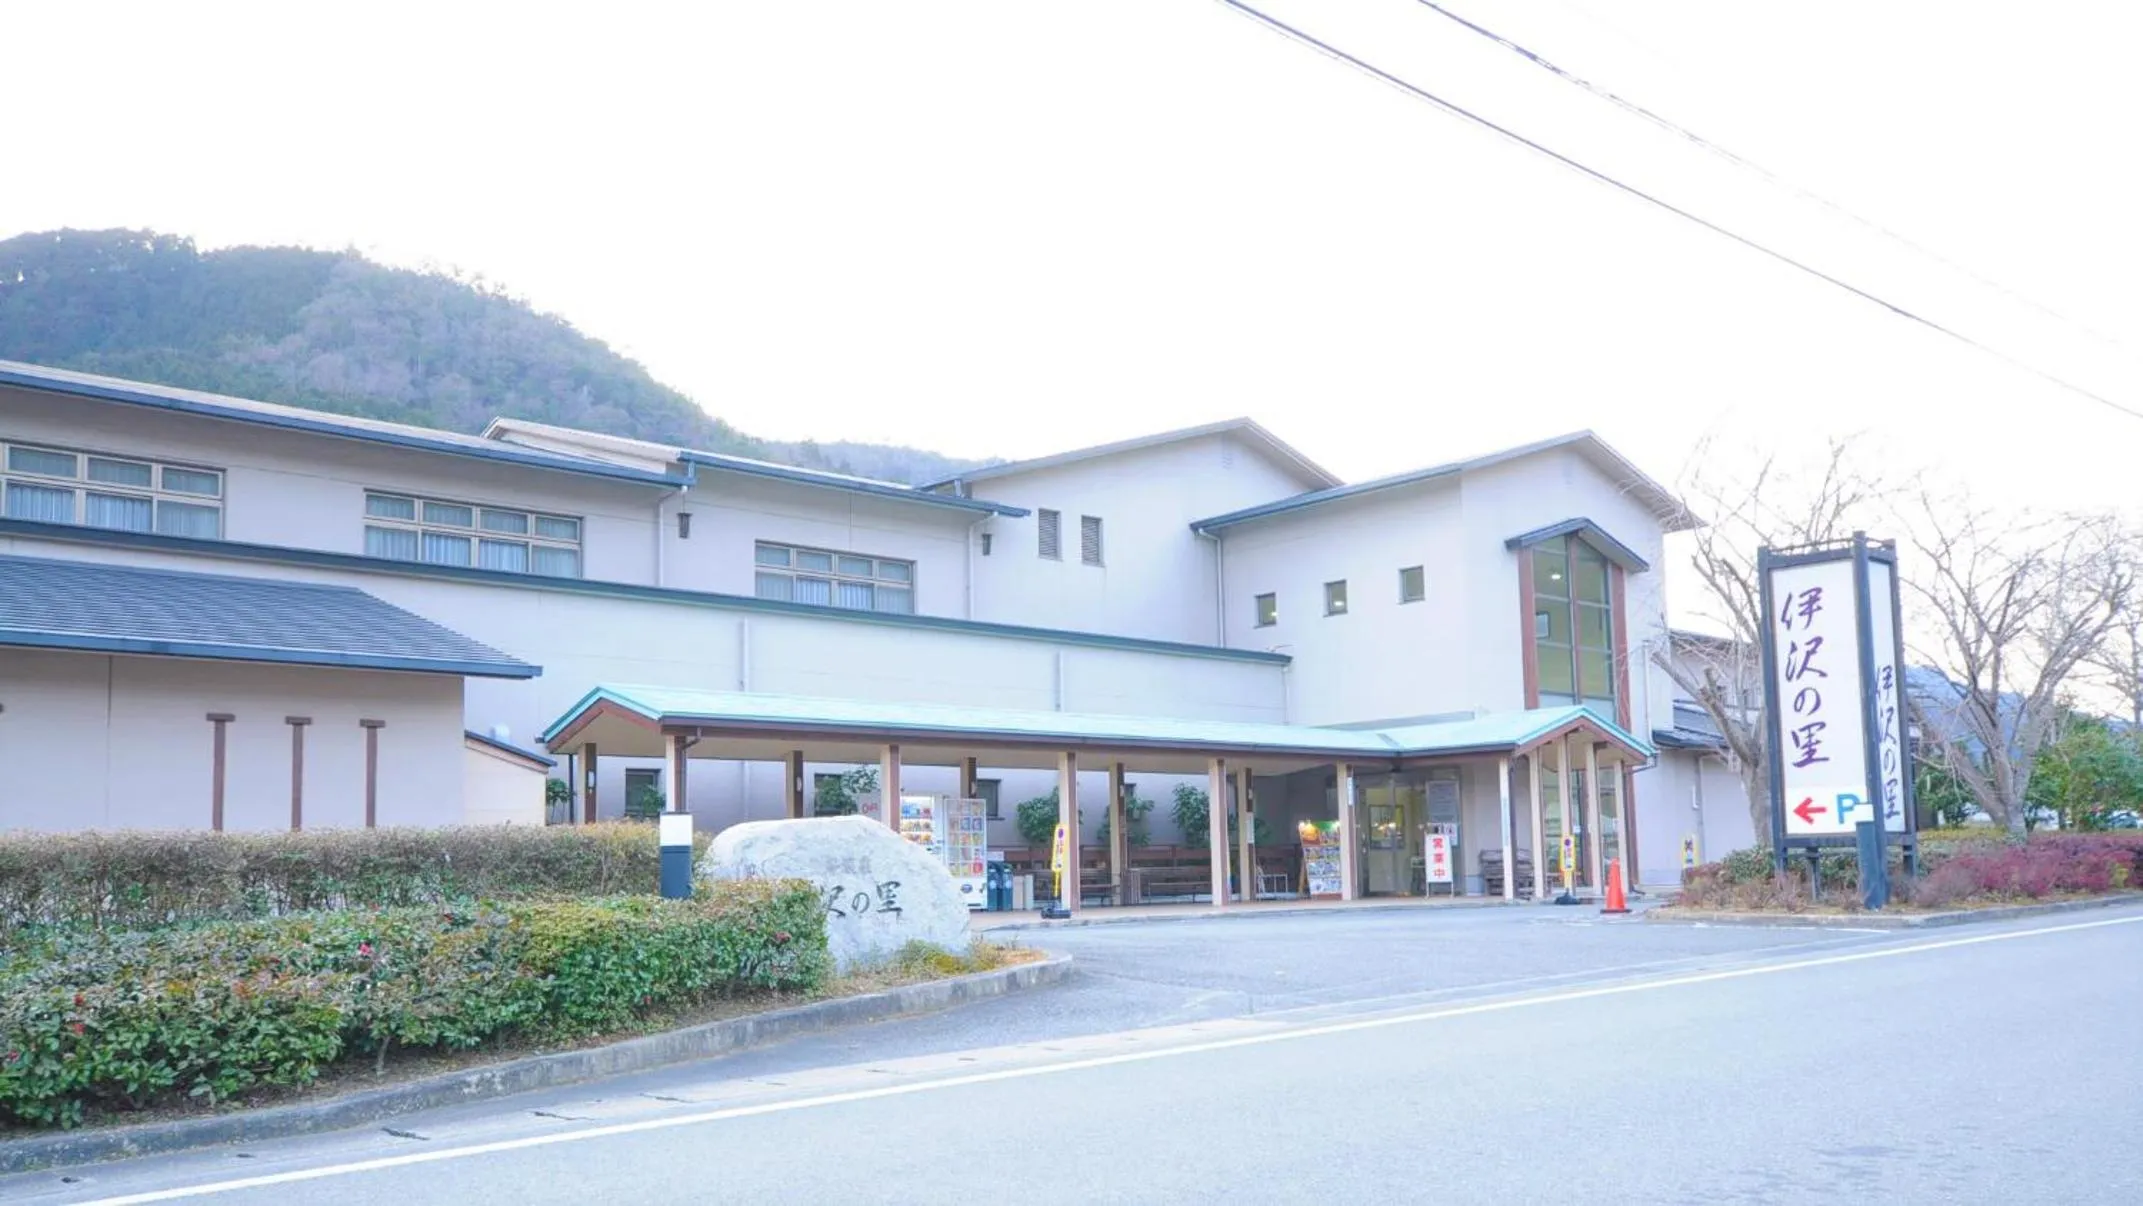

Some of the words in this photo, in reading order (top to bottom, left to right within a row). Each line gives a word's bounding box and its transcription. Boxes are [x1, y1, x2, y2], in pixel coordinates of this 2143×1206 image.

[1781, 586, 1830, 768] 伊沢の里
[1874, 665, 1900, 820] 伊沢の里
[1836, 793, 1860, 824] P
